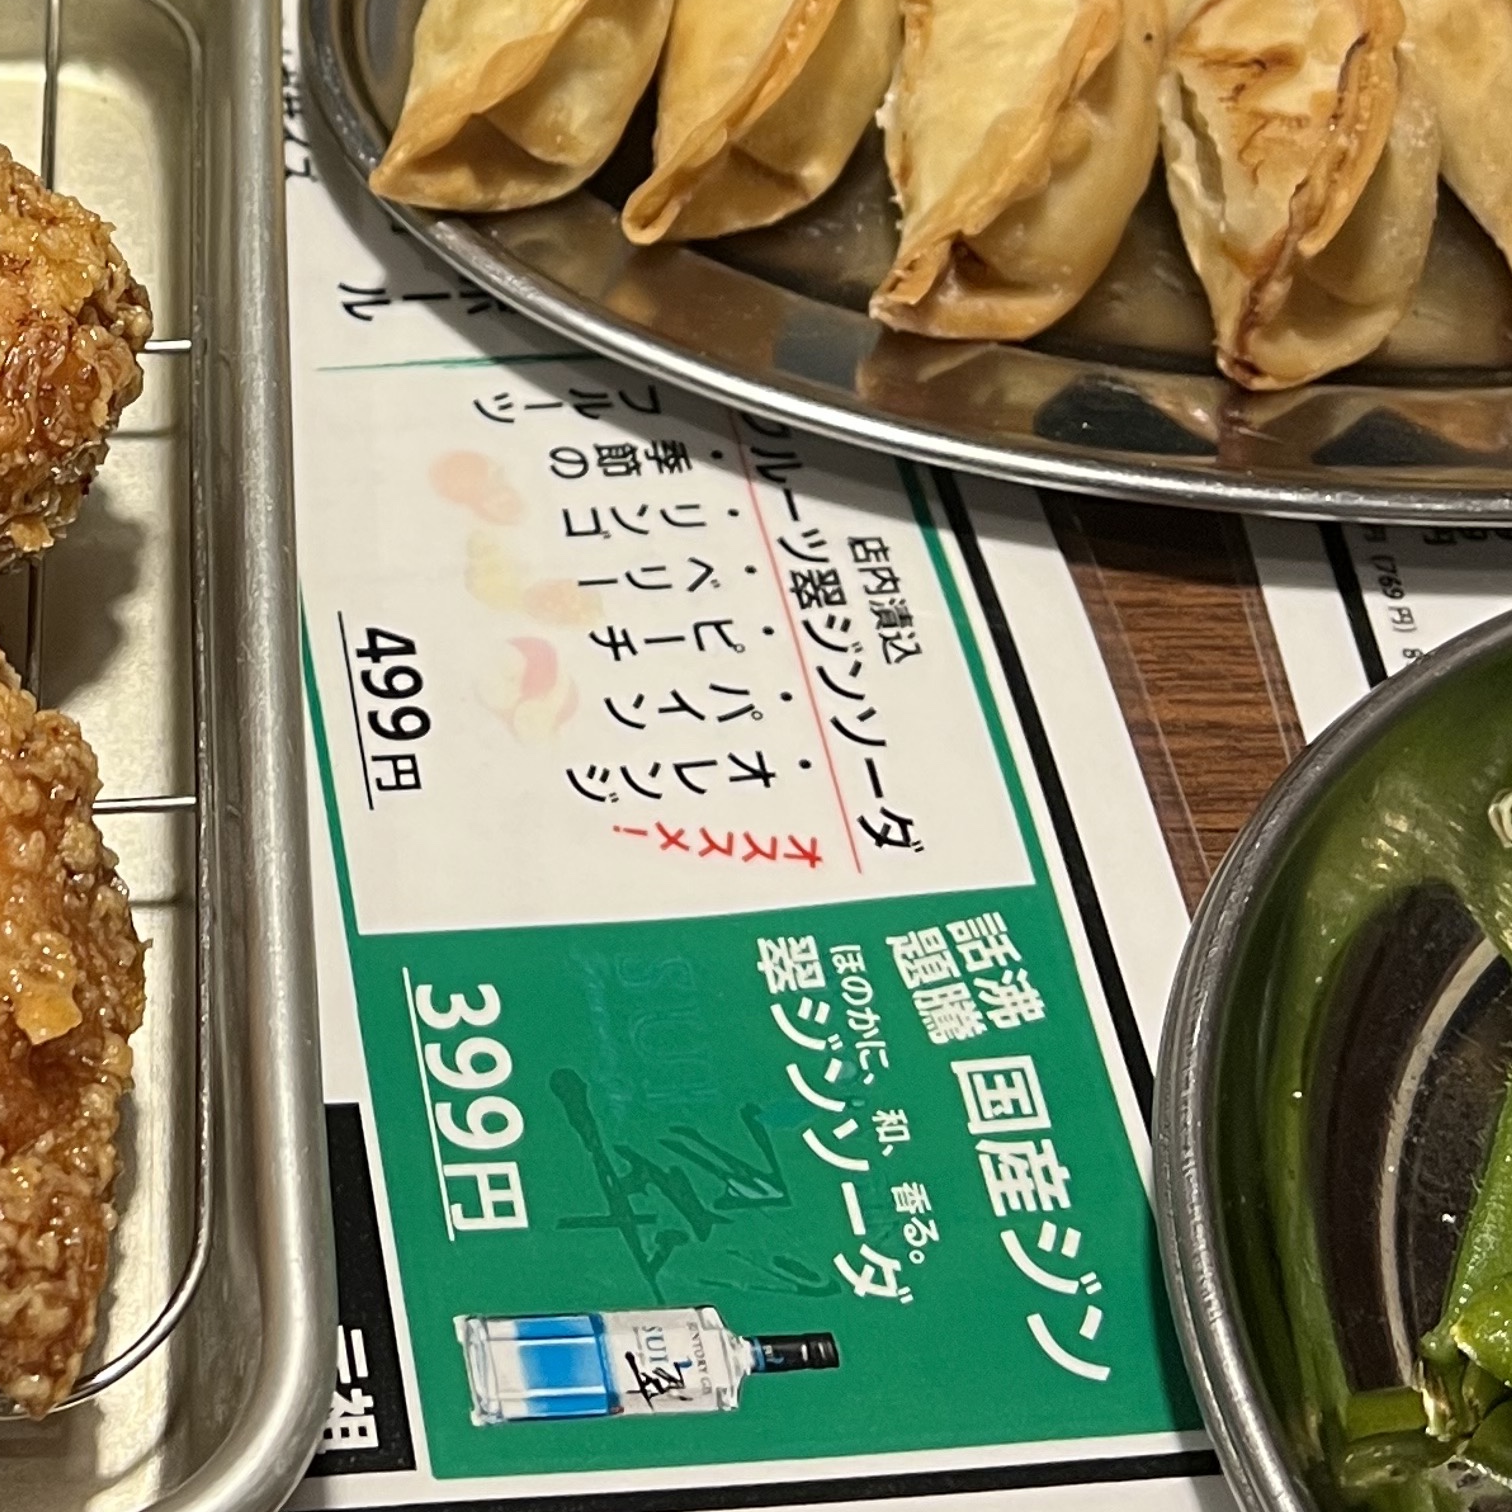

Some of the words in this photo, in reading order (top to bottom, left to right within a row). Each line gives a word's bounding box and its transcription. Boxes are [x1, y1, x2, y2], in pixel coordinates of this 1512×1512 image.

[473, 384, 661, 423] フルーツ
[847, 535, 923, 665] 店内漬込
[355, 627, 431, 792] 499円
[613, 821, 823, 869] オススメ!
[415, 979, 530, 1234] 399円
[757, 934, 915, 1304] 翠ジンソーダ
[951, 1054, 1112, 1381] 国産ジン
